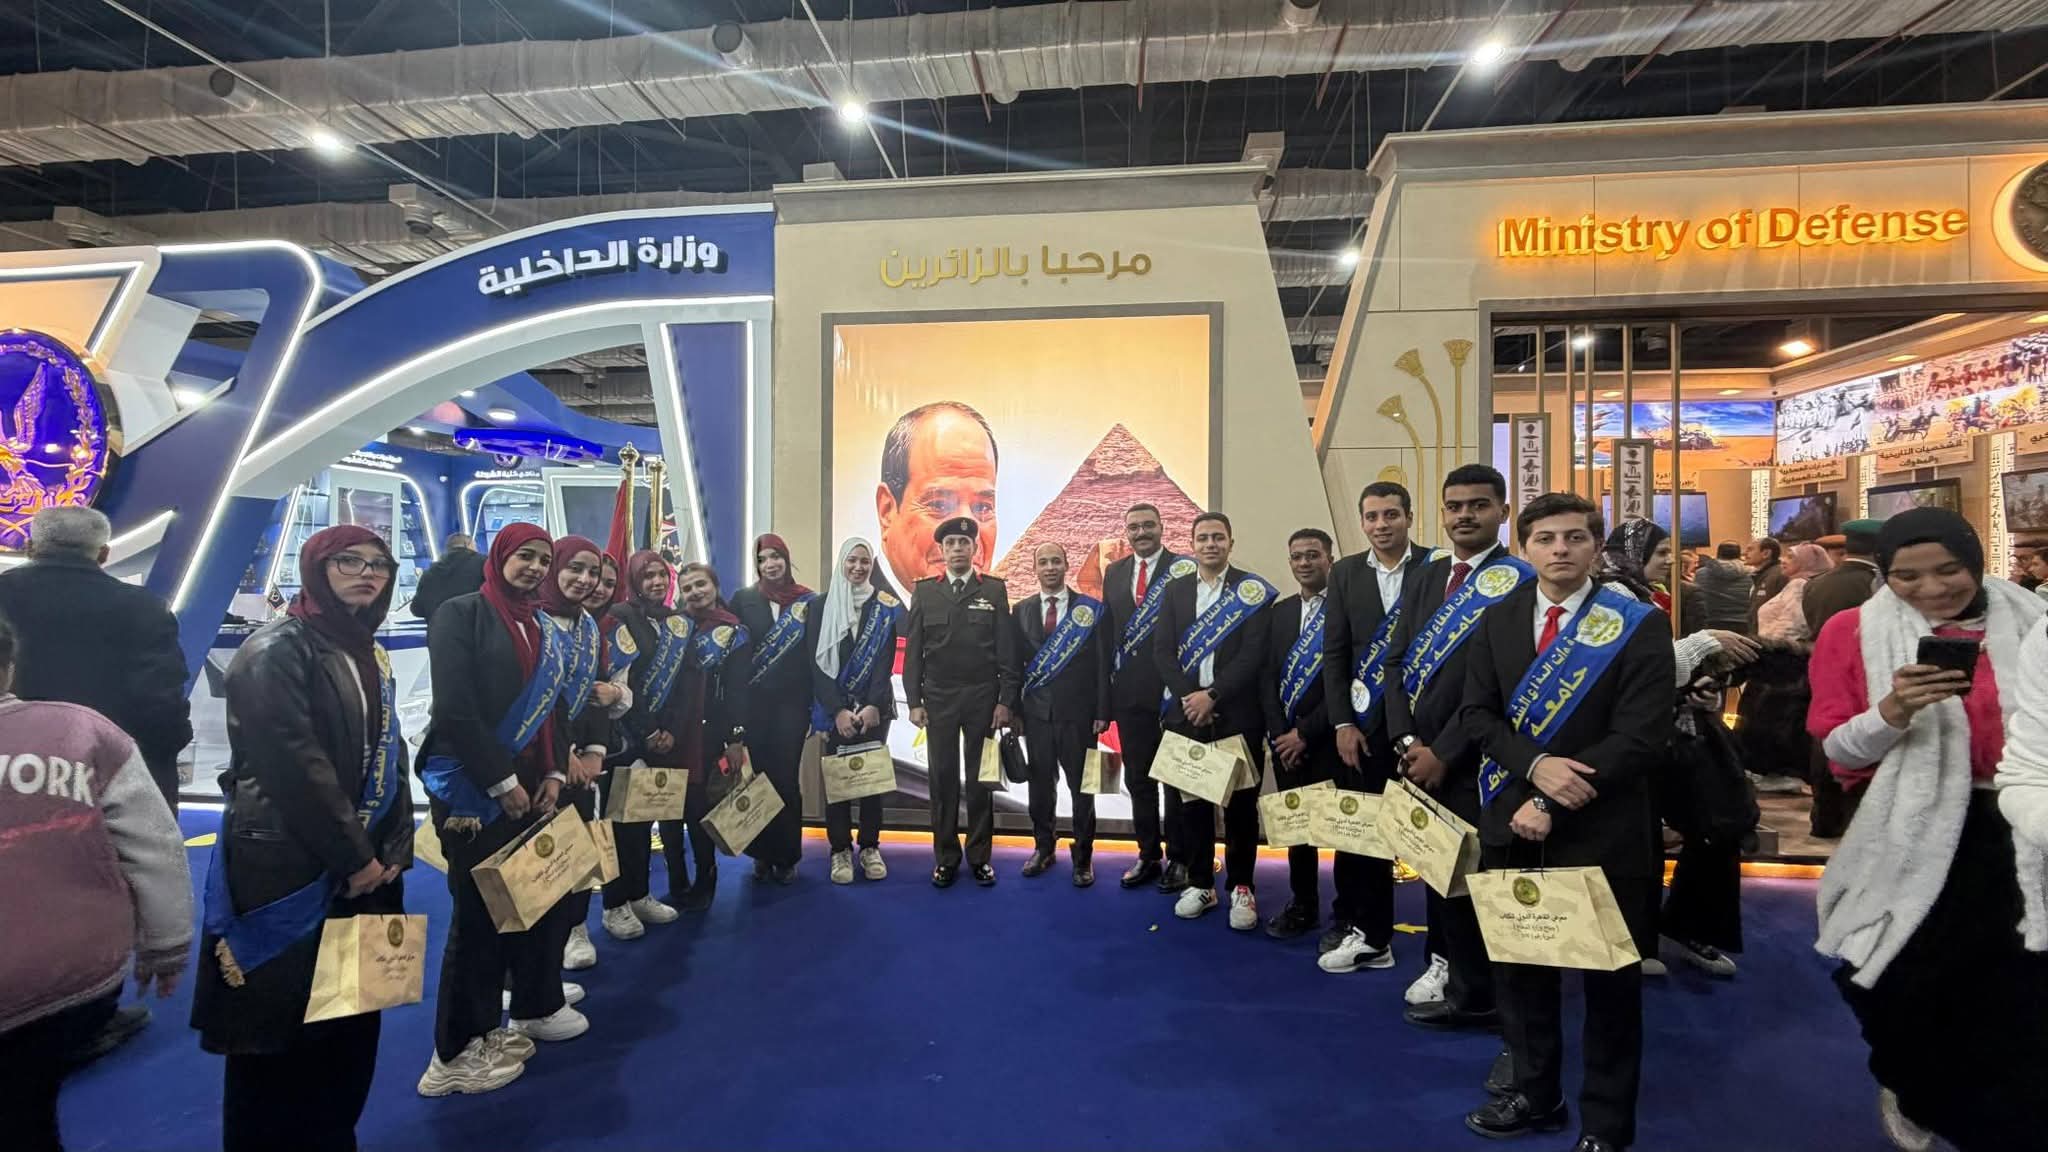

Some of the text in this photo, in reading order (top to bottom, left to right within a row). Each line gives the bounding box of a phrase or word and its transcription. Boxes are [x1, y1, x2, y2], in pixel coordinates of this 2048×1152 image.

[1498, 204, 1968, 260] Ministry of Defense
[478, 235, 719, 295] وزارة الداخلية
[880, 245, 1152, 289] مرحبا بالزائرين
[1431, 603, 1457, 635] الدفاع
[1453, 583, 1476, 608] قوات
[1201, 608, 1243, 648] جامعة
[1429, 595, 1487, 662] جامعة
[1524, 665, 1589, 738] جامعة
[0, 753, 95, 807] ORK
